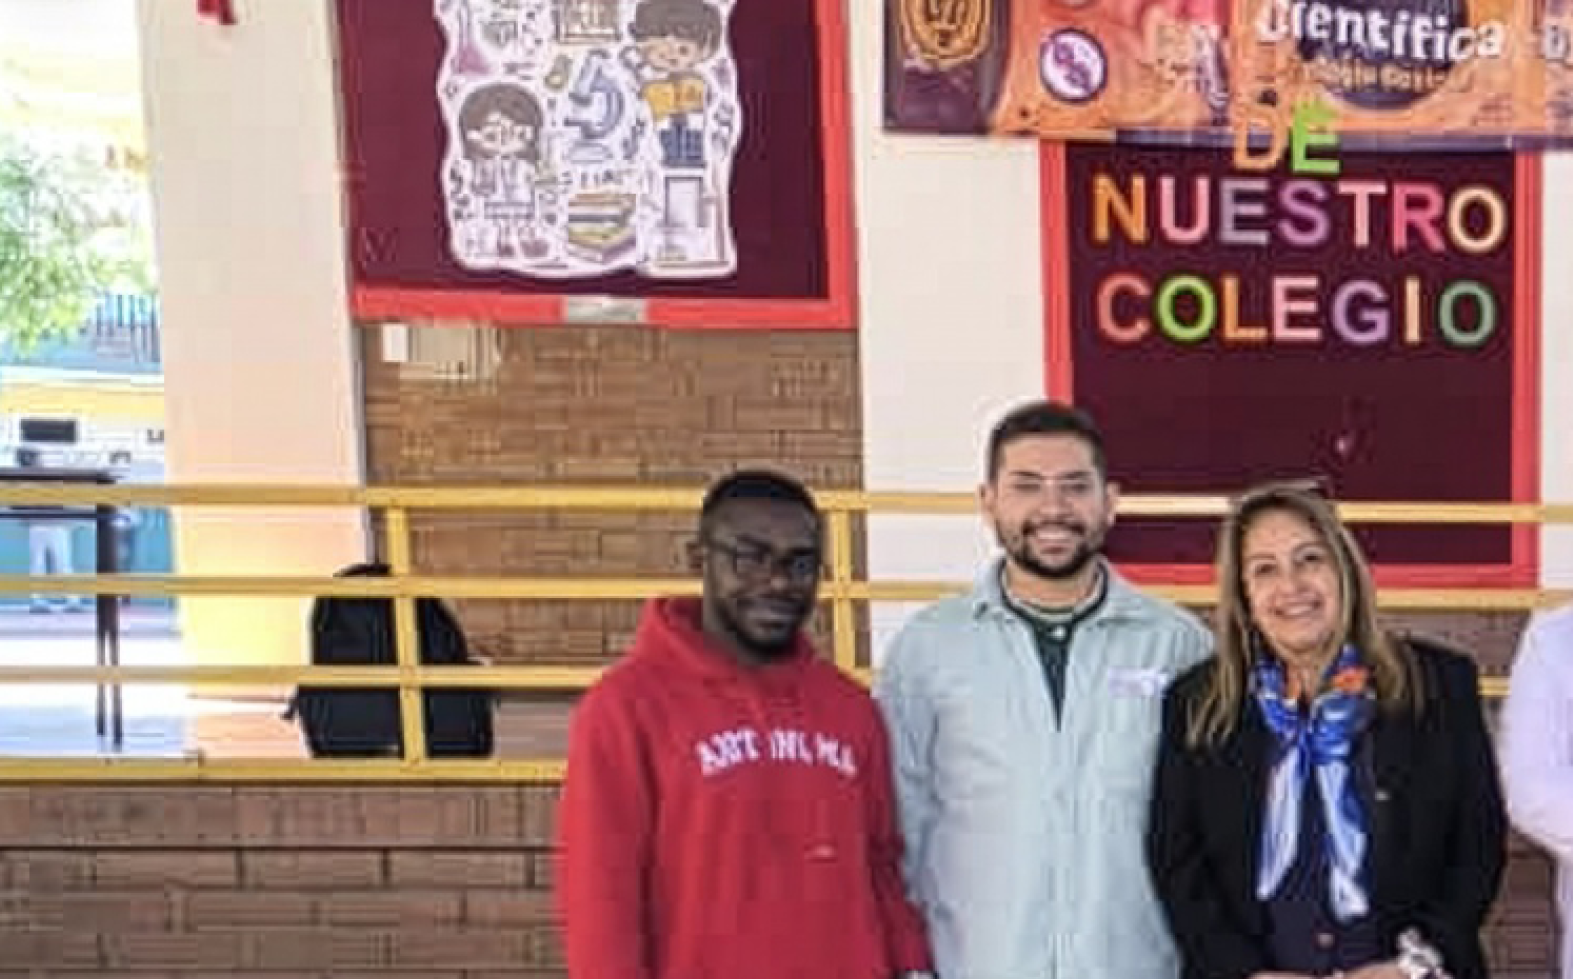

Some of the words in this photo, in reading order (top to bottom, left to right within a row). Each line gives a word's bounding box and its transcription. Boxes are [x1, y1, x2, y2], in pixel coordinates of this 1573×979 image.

[1233, 102, 1340, 173] DE
[1093, 176, 1506, 252] NUESTRO
[1099, 273, 1496, 345] COLEGIO
